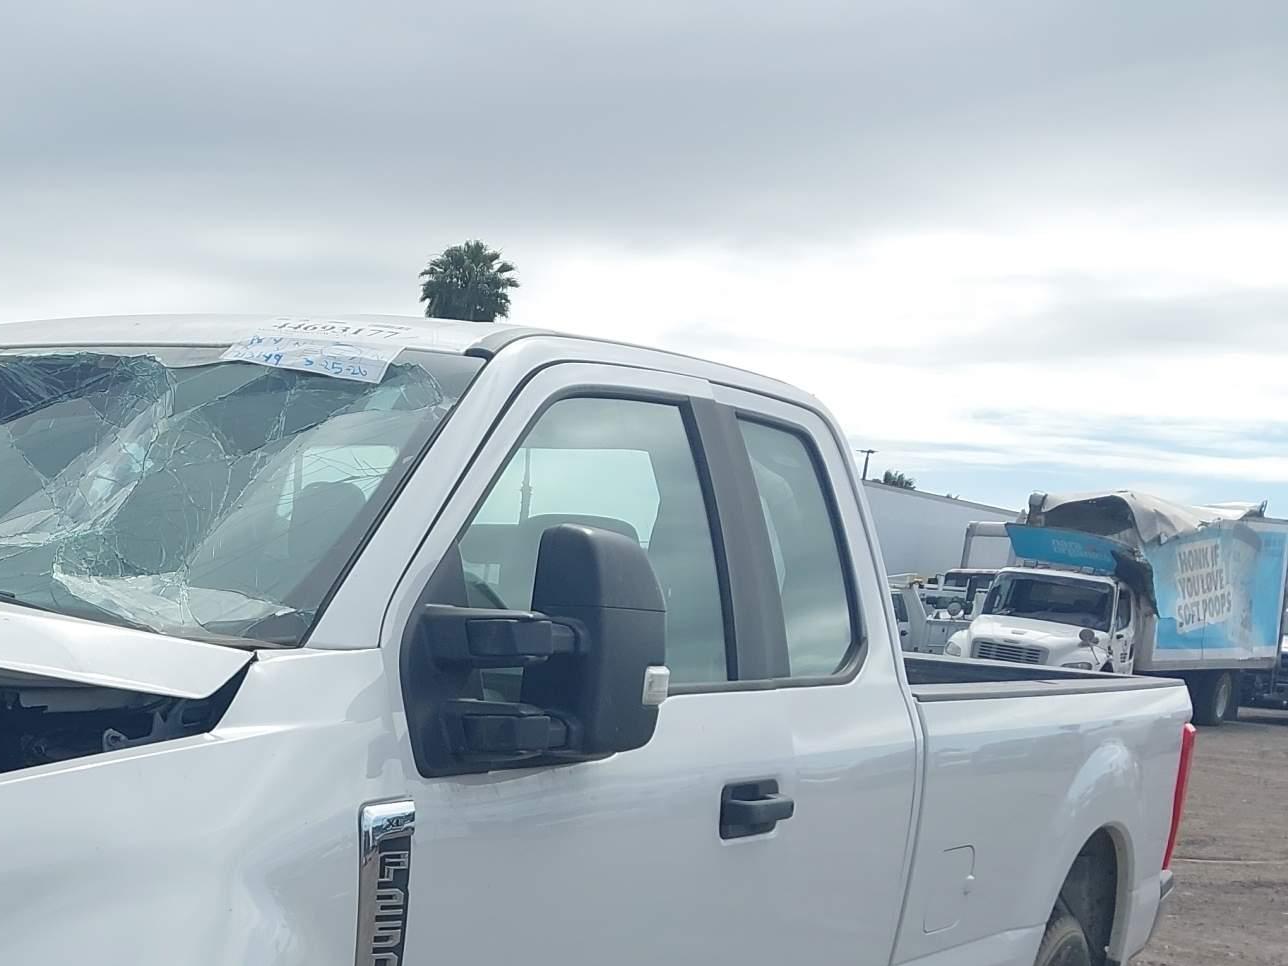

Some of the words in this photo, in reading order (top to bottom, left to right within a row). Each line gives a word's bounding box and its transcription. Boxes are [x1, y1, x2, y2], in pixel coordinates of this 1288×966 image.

[272, 321, 400, 339] 44693177
[1178, 547, 1209, 573] HONK
[1178, 574, 1199, 601] YOU
[1200, 568, 1224, 594] LOVE
[1177, 600, 1200, 629] SOFT
[1201, 591, 1232, 623] POOPS
